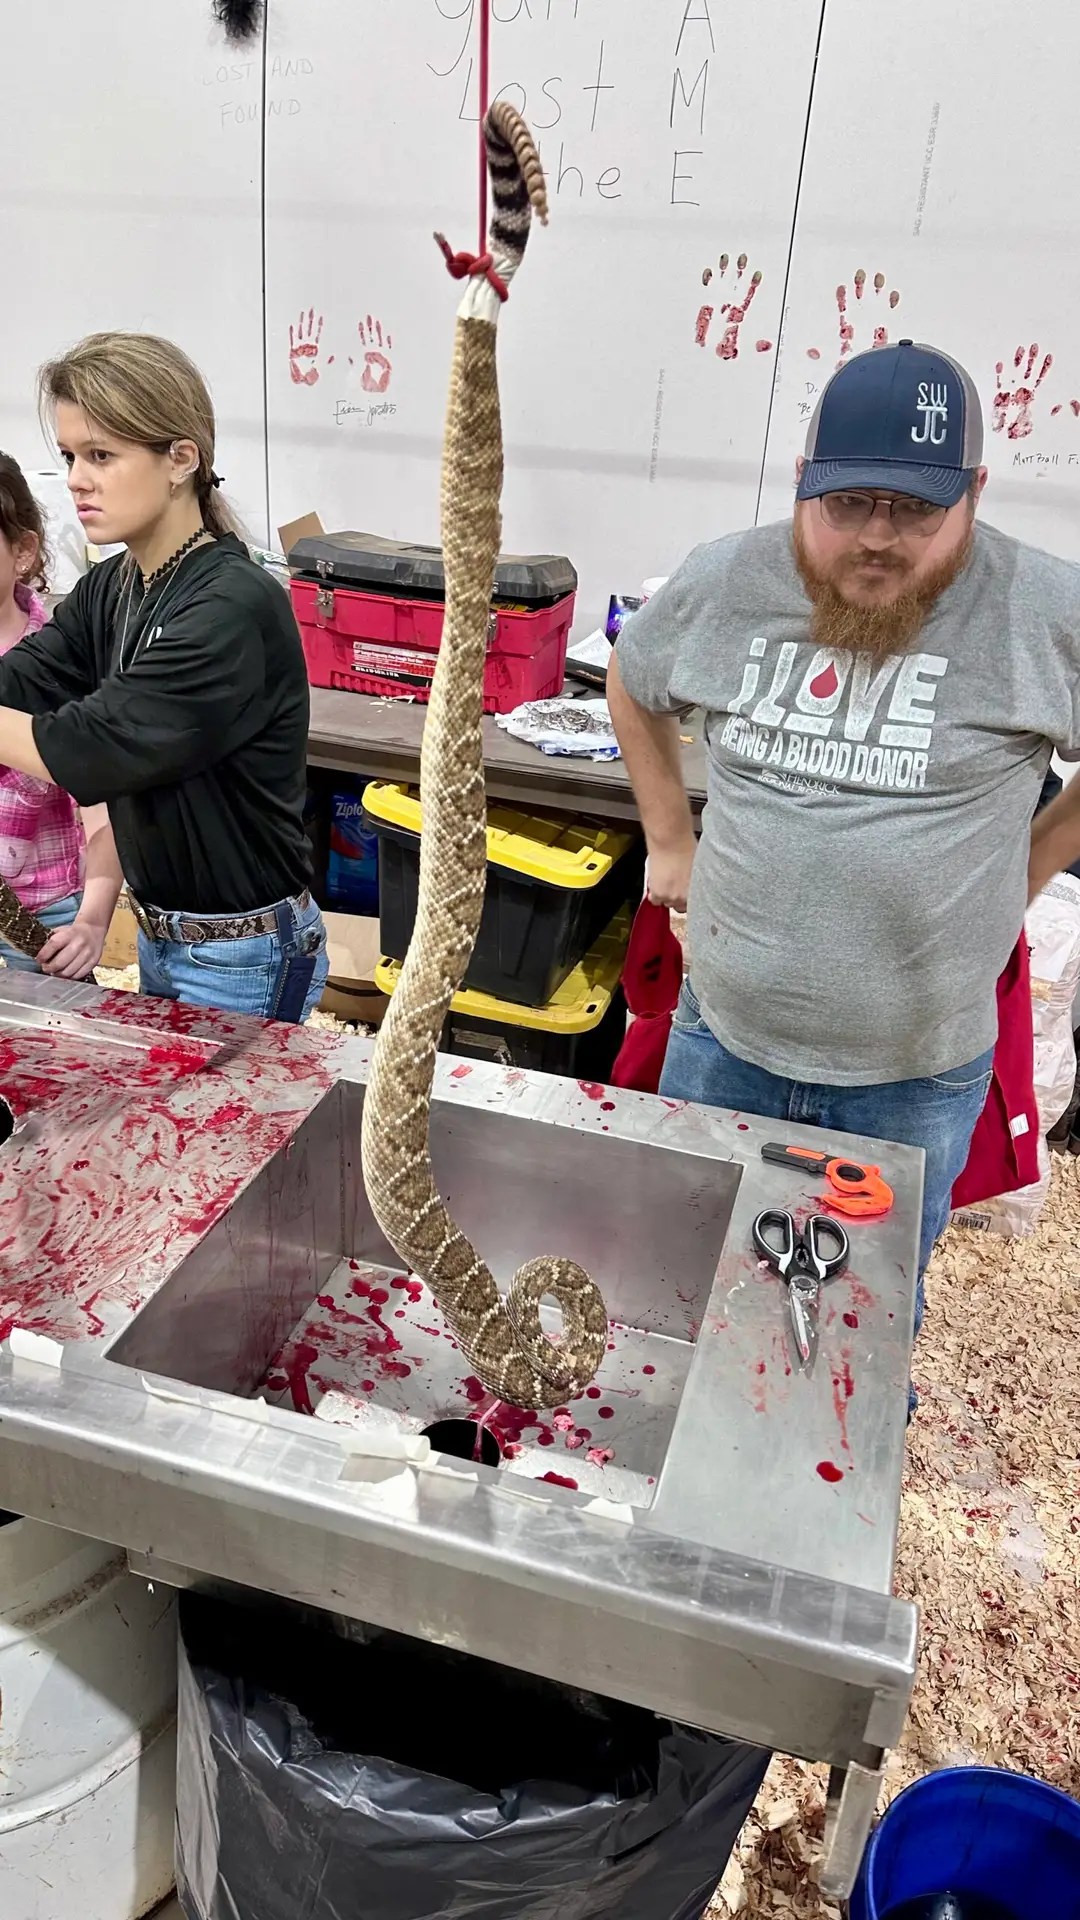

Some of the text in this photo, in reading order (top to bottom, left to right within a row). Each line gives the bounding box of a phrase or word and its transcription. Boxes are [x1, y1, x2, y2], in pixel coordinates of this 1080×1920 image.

[271, 55, 314, 77] AND
[219, 98, 301, 131] FOUND
[917, 381, 948, 406] SW
[910, 405, 948, 445] JC
[720, 714, 930, 789] BEING A BLOOD DONOR
[335, 802, 364, 819] Ziplo
